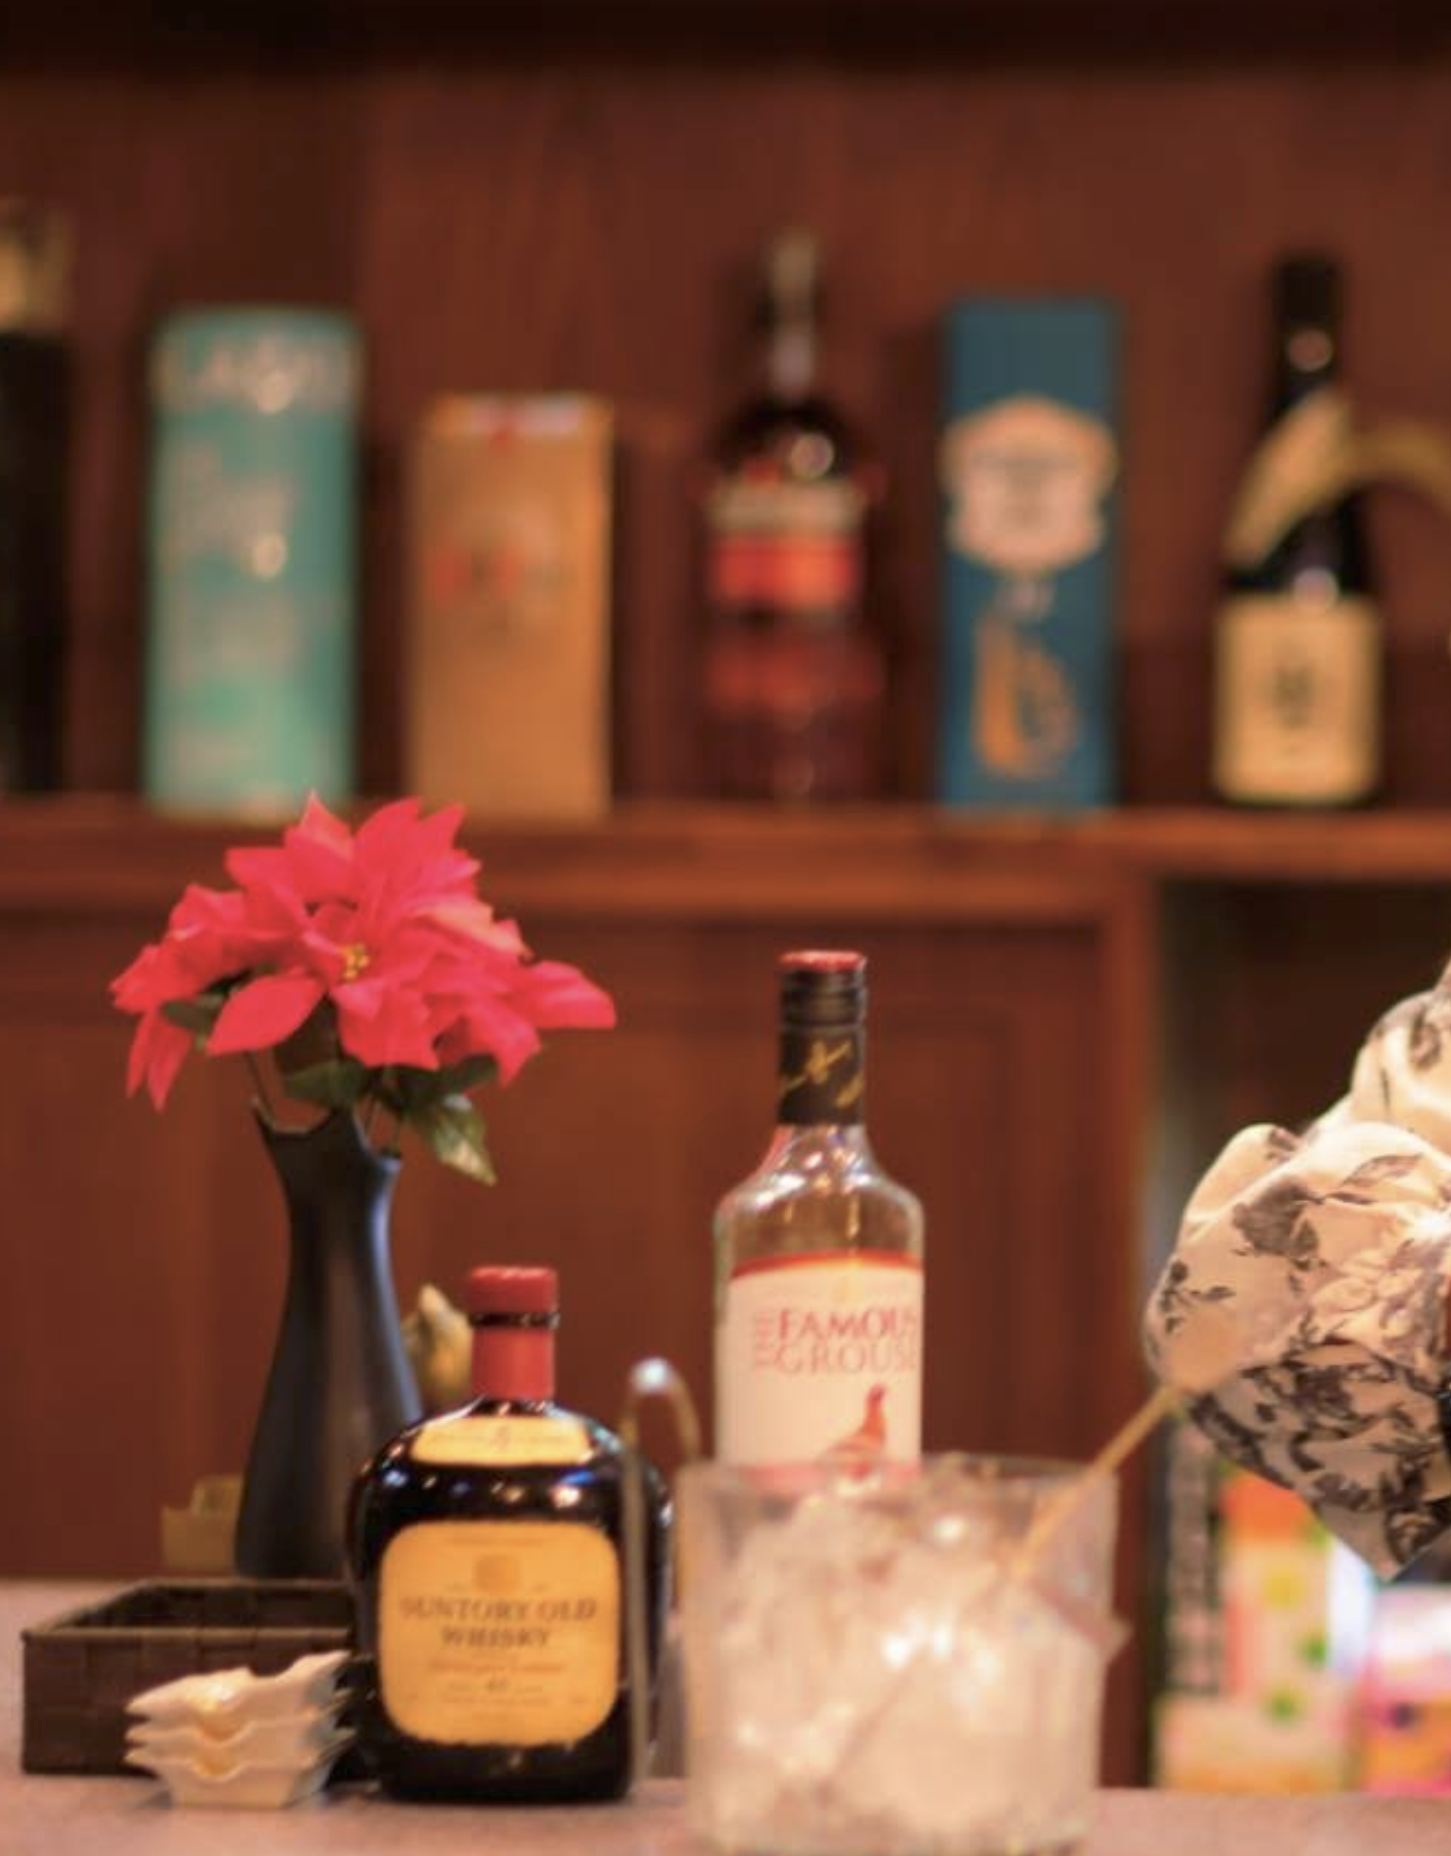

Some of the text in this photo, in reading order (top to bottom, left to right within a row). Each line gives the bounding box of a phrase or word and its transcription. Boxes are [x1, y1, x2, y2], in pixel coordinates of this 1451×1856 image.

[399, 1597, 598, 1621] SUNTORY OLD
[441, 1625, 551, 1650] WHISKY
